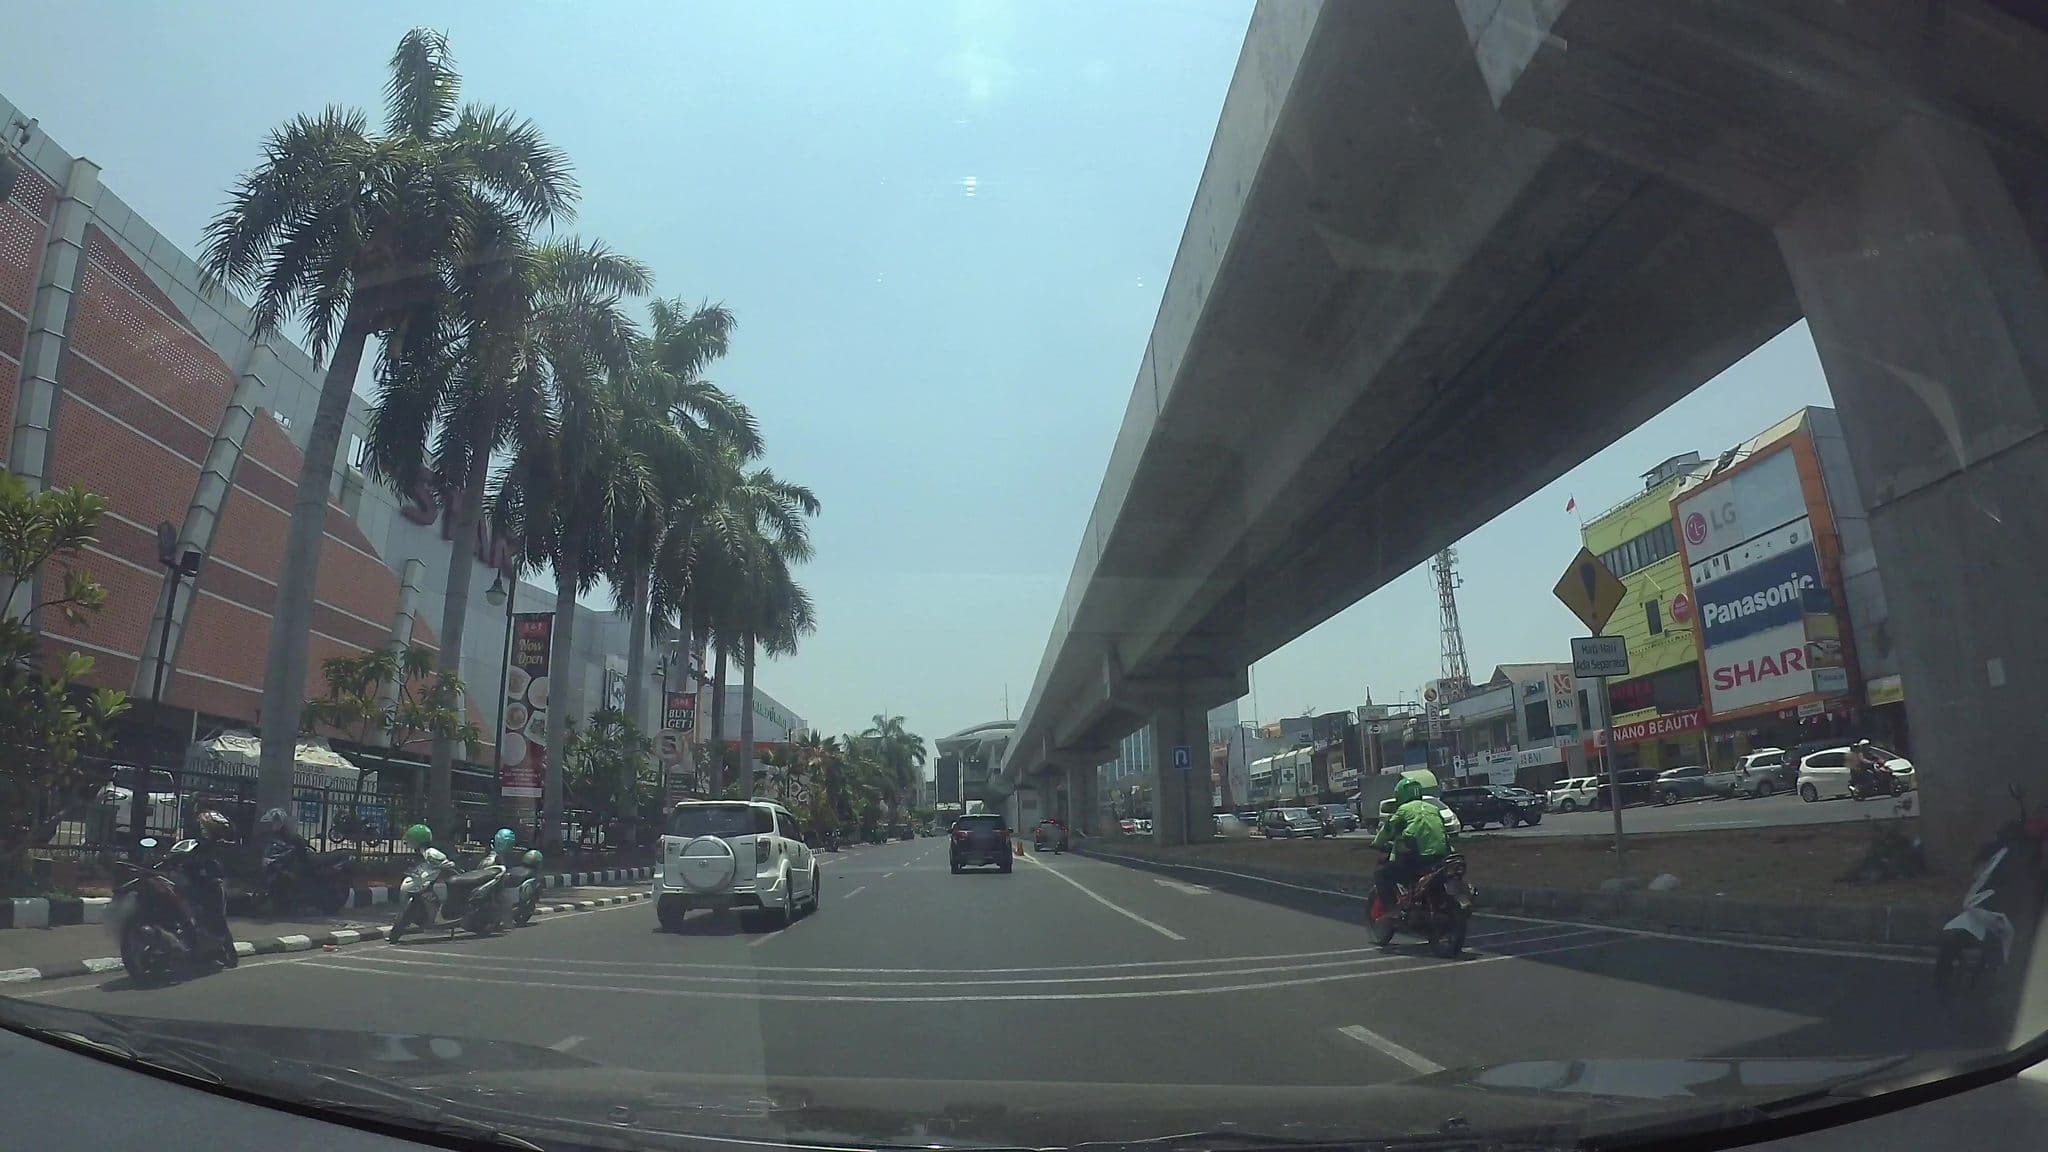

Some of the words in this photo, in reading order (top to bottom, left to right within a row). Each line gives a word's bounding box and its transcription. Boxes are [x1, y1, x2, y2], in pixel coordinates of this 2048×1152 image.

[1710, 502, 1737, 530] LG
[1702, 571, 1815, 629] Panasonic
[518, 638, 544, 652] Now
[518, 651, 543, 666] Open
[1712, 647, 1812, 691] SHAR
[1556, 699, 1574, 709] BNI
[669, 709, 690, 719] BUY
[667, 719, 688, 729] GET
[1613, 725, 1645, 742] NANO
[1648, 713, 1698, 735] BEAUTY
